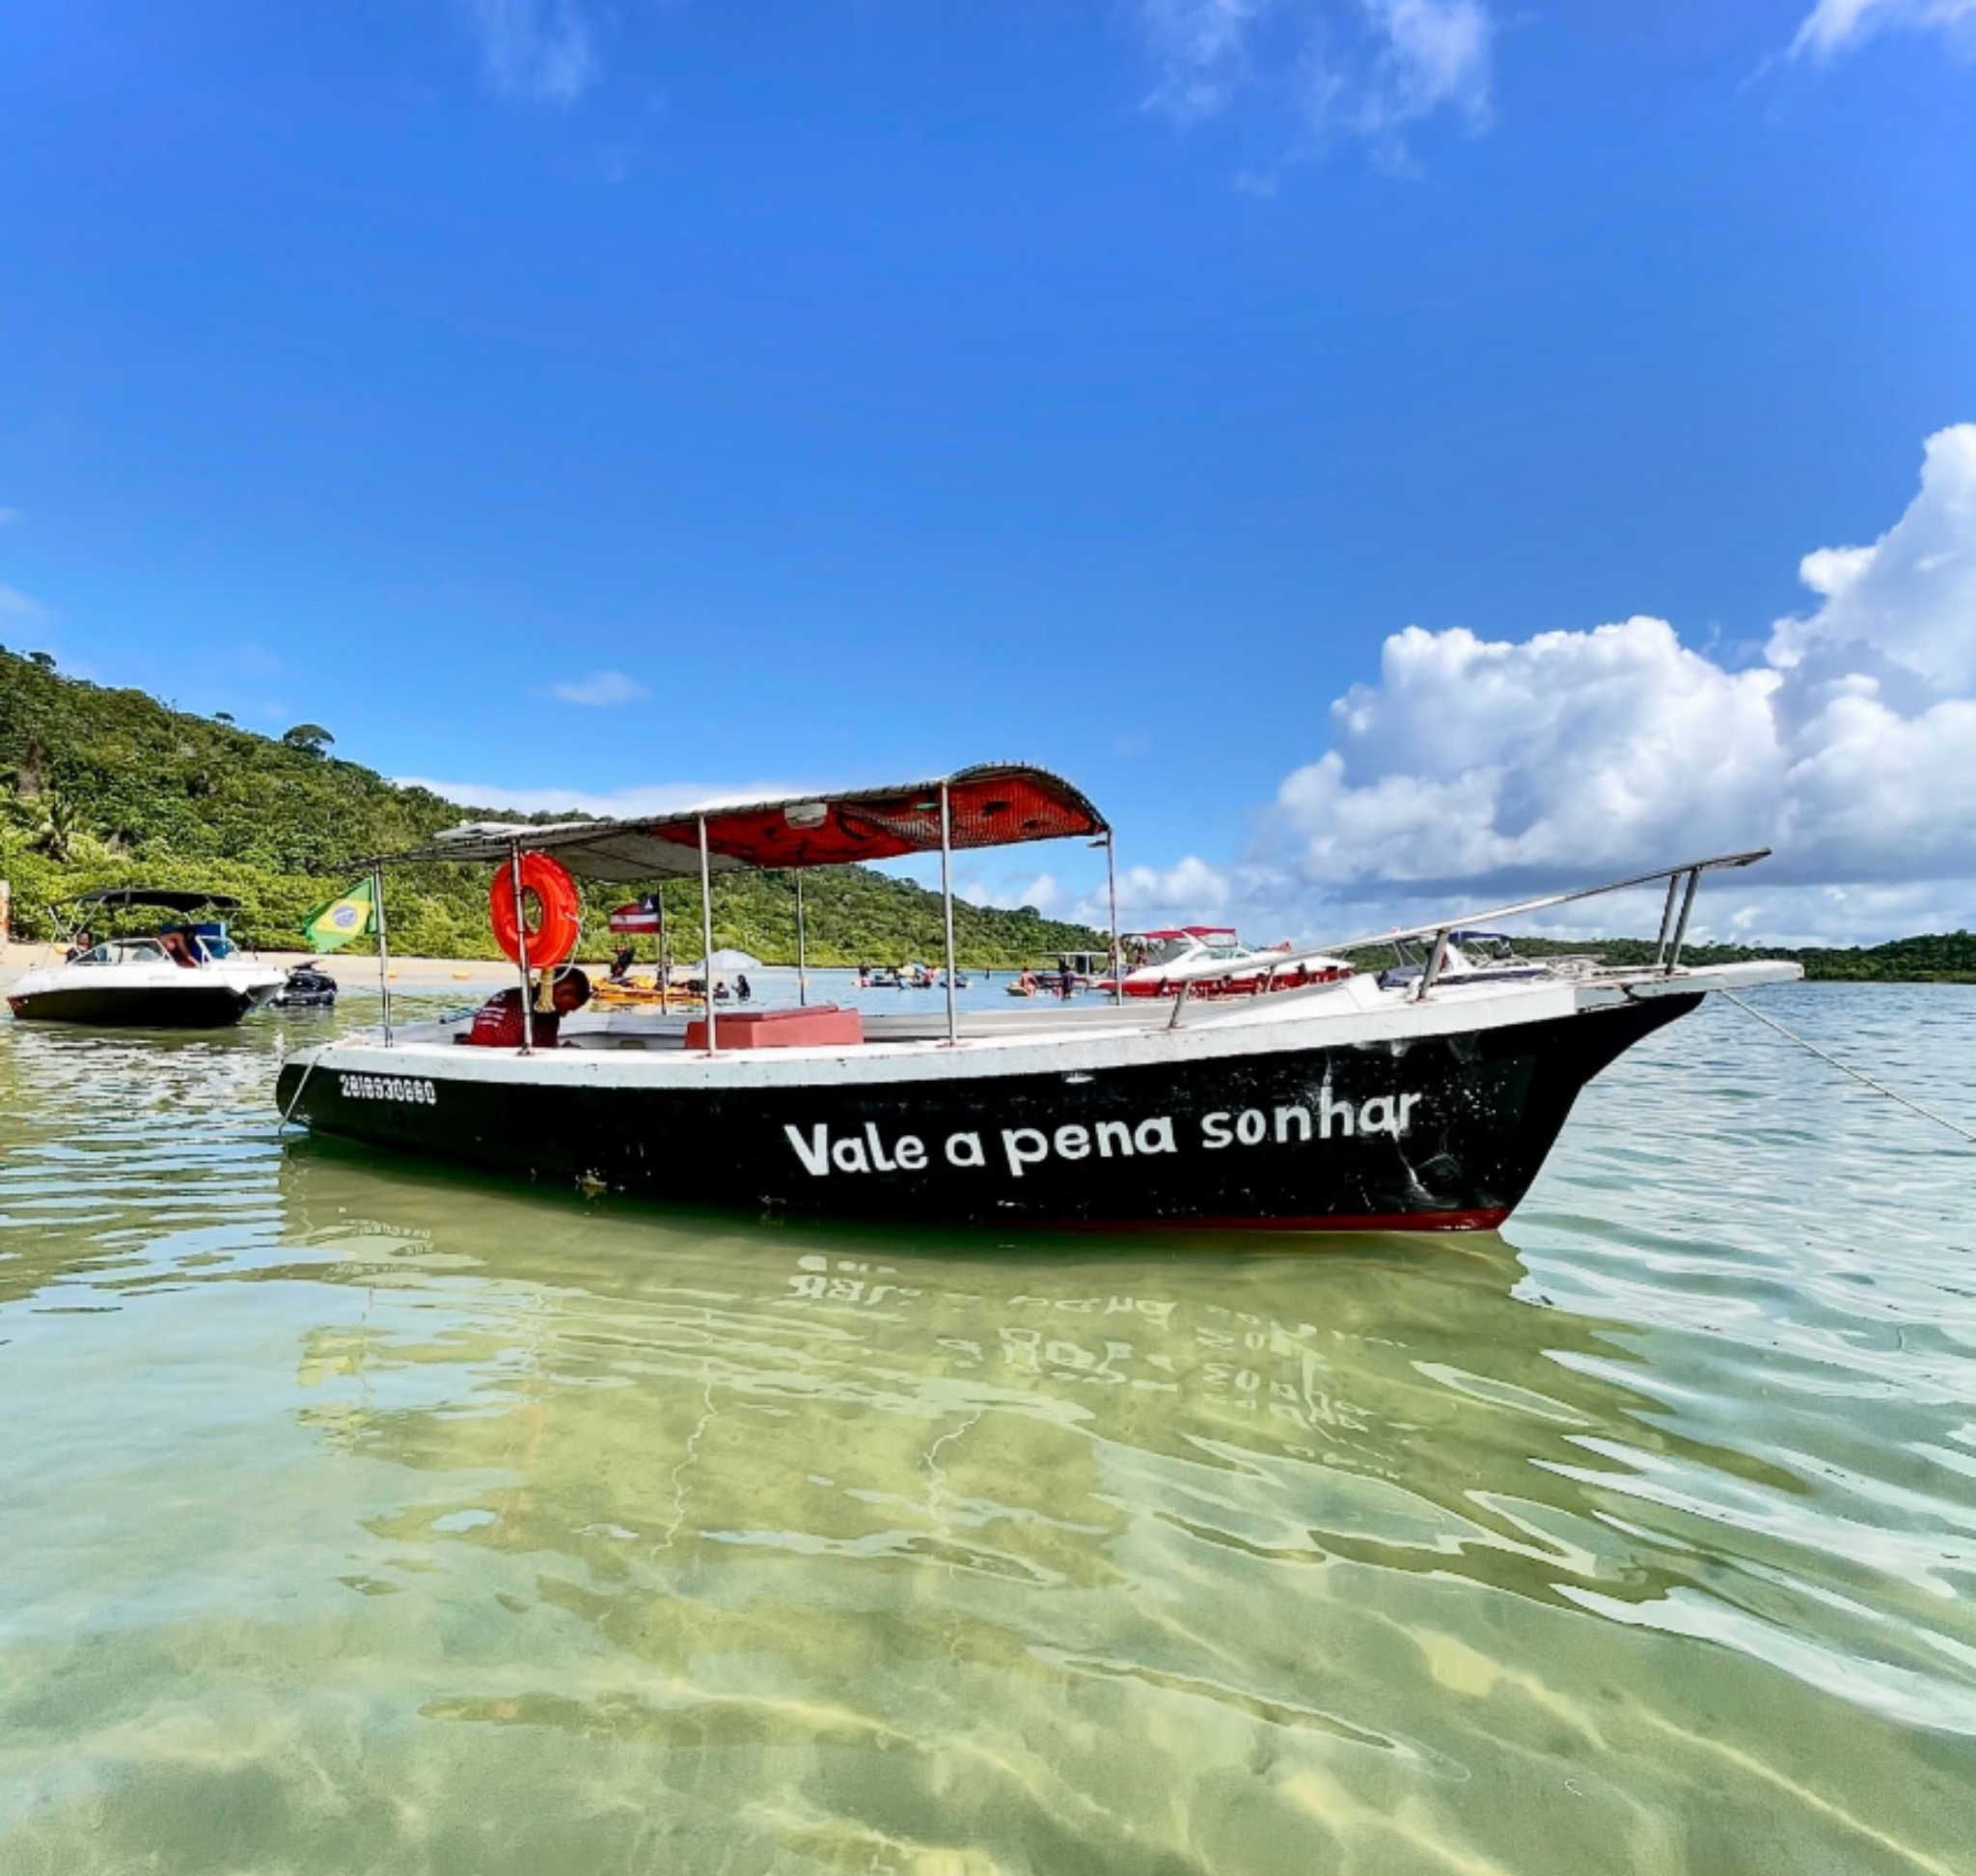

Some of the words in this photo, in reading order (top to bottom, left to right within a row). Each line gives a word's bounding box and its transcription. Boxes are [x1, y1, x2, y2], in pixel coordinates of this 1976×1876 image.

[783, 1122, 928, 1176] Vale
[945, 1132, 986, 1167] a
[1002, 1117, 1177, 1176] pena
[1201, 1087, 1422, 1148] sonhar
